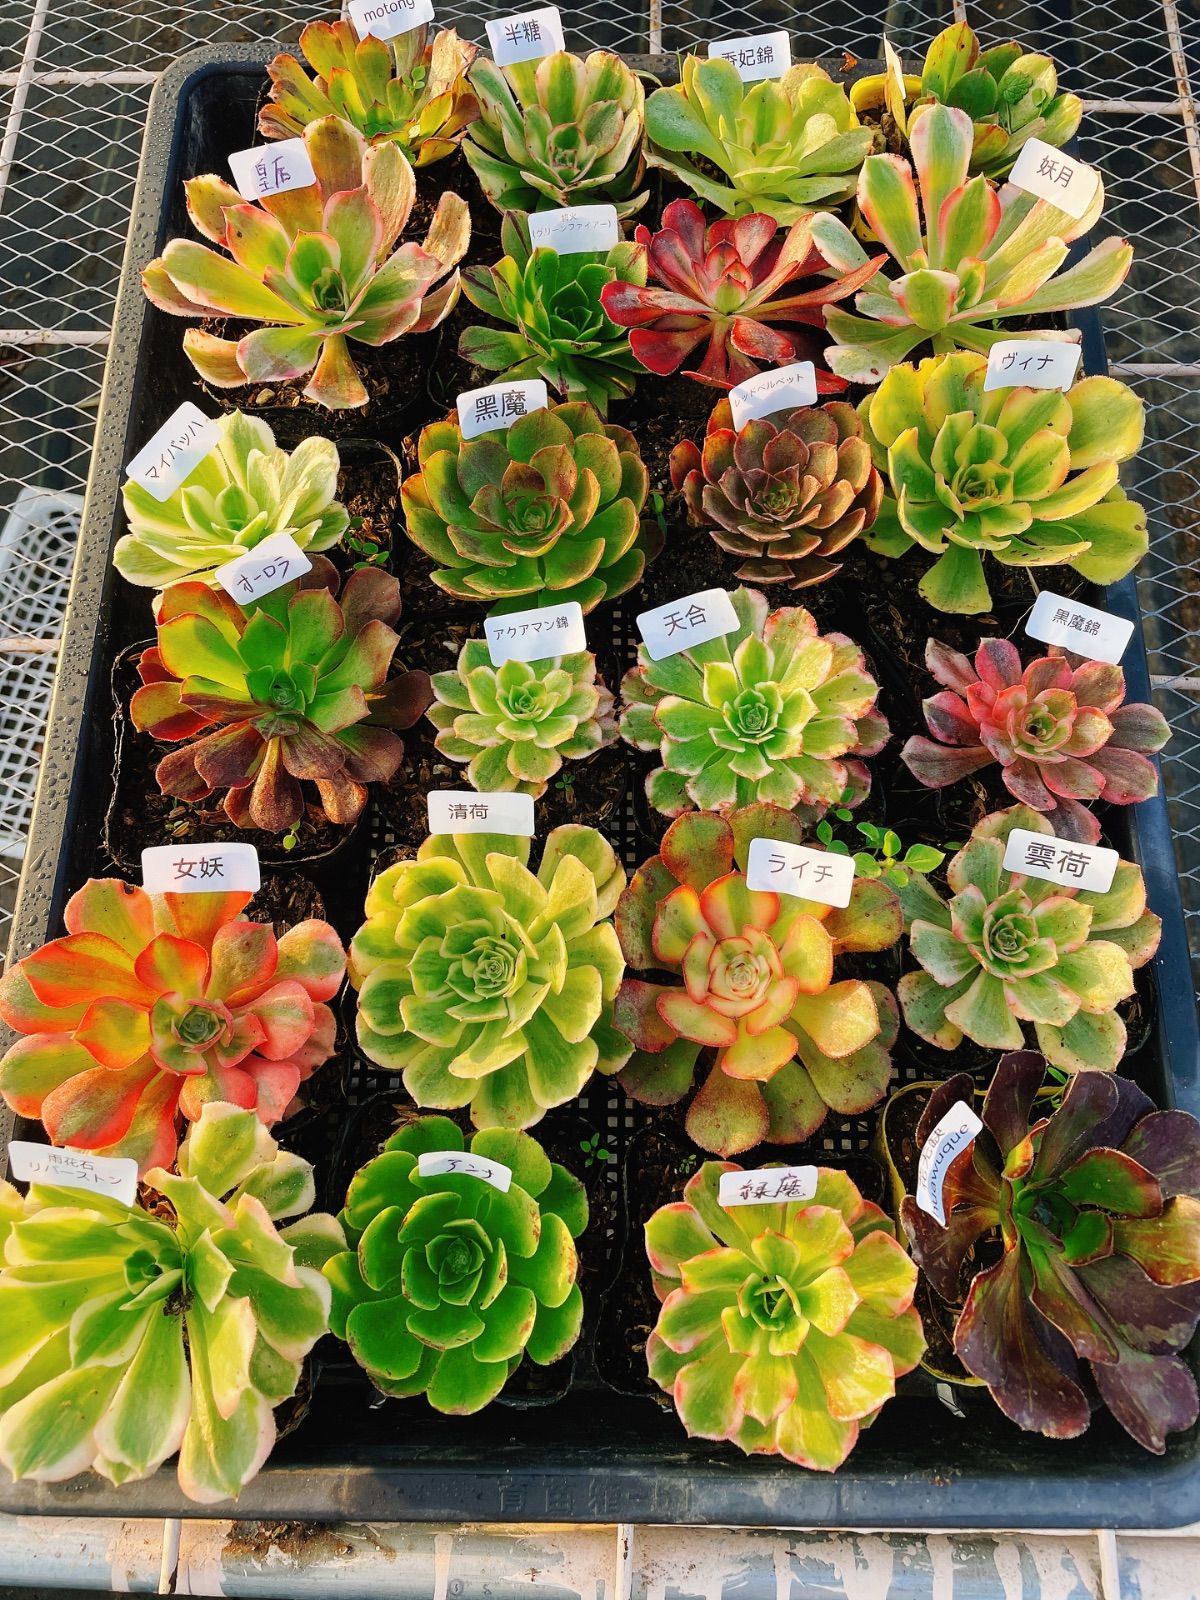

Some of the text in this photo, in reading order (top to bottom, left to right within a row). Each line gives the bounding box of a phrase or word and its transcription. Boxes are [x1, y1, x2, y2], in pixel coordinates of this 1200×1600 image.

[363, 0, 416, 23] motong
[505, 18, 541, 46] 半糖
[1036, 155, 1074, 188] 妖月
[1002, 352, 1054, 371] ヴィナ
[145, 420, 204, 479] マイバッハ
[237, 555, 291, 594] オーロラ
[493, 616, 568, 641] アクアマン錦
[663, 604, 707, 636] 天合
[448, 803, 488, 819] 清荷
[173, 857, 224, 880] 女妖
[768, 853, 834, 883] ライチ
[1024, 841, 1091, 877] 雲荷
[29, 1161, 122, 1185] リバーストン
[48, 1153, 94, 1171] 雨花石
